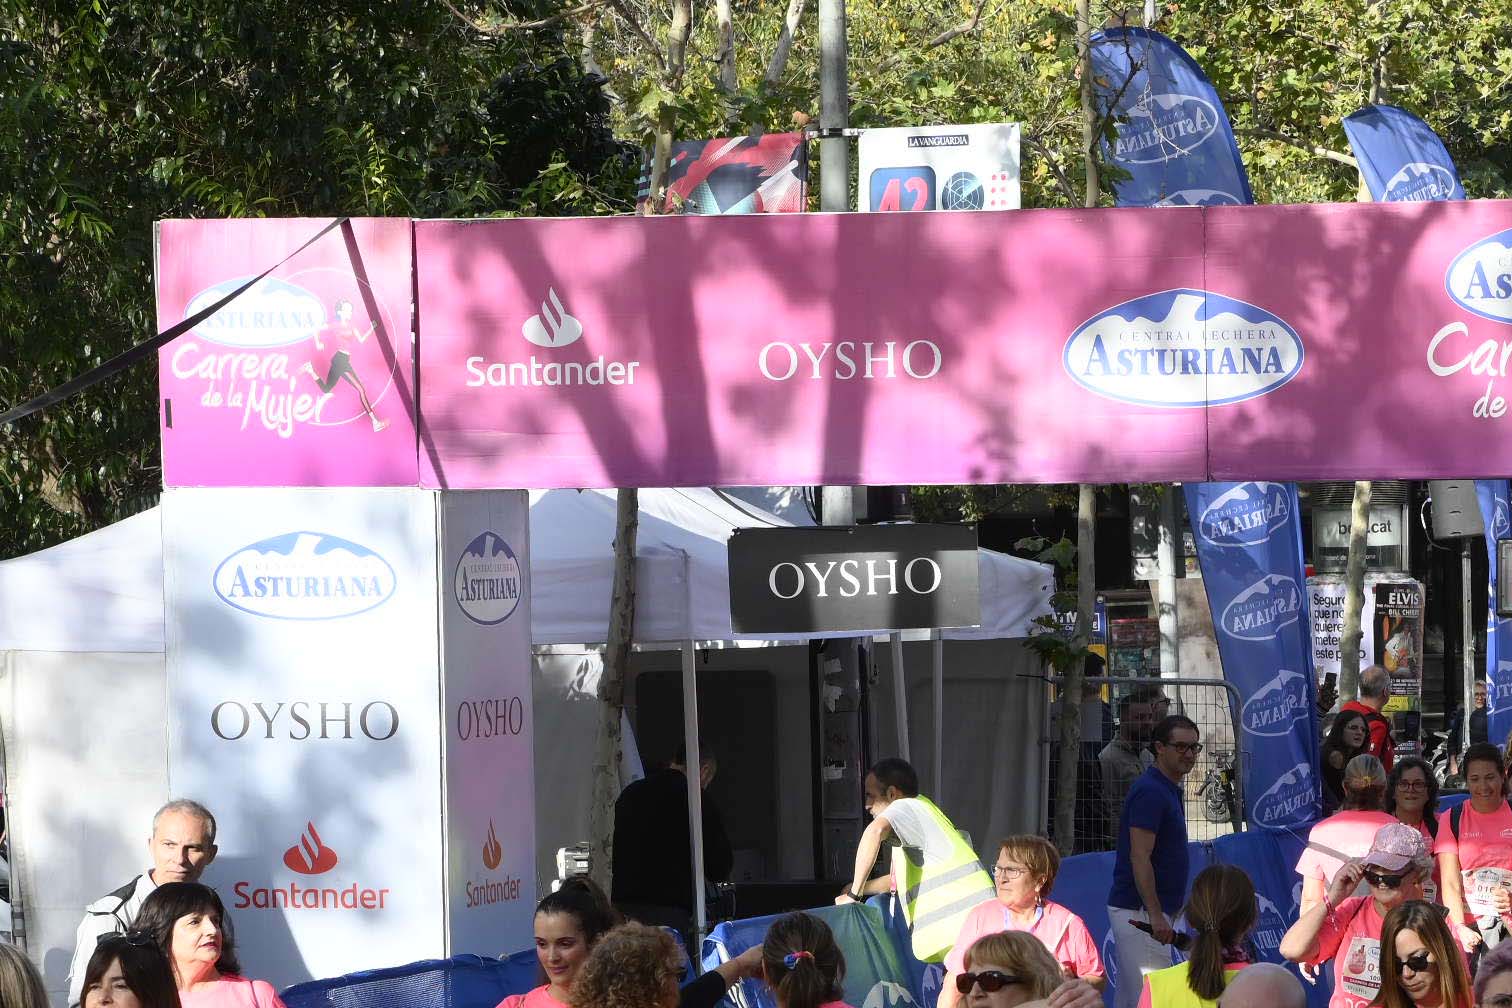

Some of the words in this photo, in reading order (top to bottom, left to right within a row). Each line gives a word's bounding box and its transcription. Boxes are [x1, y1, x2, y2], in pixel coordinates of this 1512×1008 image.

[1119, 328, 1190, 344] CENTRAL
[1202, 327, 1277, 343] LECHERA
[171, 342, 290, 381] Carrera
[466, 355, 639, 388] Santander
[758, 338, 942, 382] OYSHO
[1083, 333, 1285, 378] ASTURIANA
[201, 379, 224, 409] de
[227, 380, 244, 409] la
[240, 376, 334, 439] Mujer
[1472, 384, 1506, 421] de
[228, 565, 383, 598] ASTURIANA
[459, 567, 518, 603] ASTURIANA
[769, 557, 942, 599] OYSHO
[1314, 610, 1330, 621] que
[1389, 592, 1419, 605] ELVIS
[1314, 621, 1344, 632] quiere
[1315, 649, 1334, 659] este
[210, 700, 399, 741] OYSHO
[457, 697, 523, 742] OYSHO
[234, 881, 389, 910] Santander
[466, 877, 520, 908] Santander
